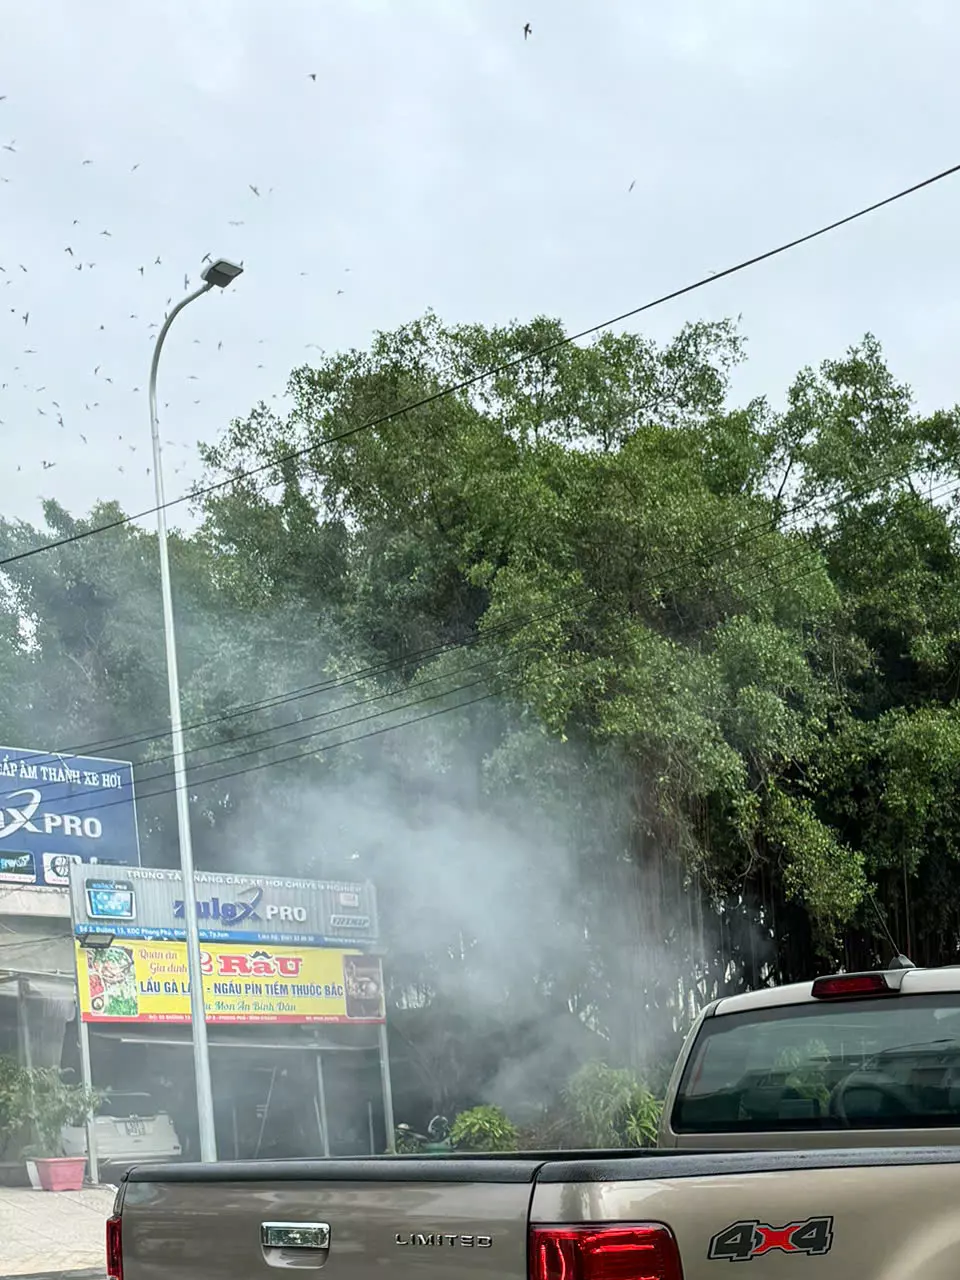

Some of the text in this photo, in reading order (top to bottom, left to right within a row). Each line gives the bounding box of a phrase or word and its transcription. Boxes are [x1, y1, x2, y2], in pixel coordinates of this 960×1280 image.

[20, 760, 38, 779] ÂM
[40, 766, 82, 785] THANH
[83, 771, 99, 786] XE
[101, 772, 123, 789] HƠI
[42, 812, 103, 838] PRO
[126, 869, 164, 880] TRUNG
[265, 904, 307, 922] PRO
[396, 1233, 493, 1248] LIMITED
